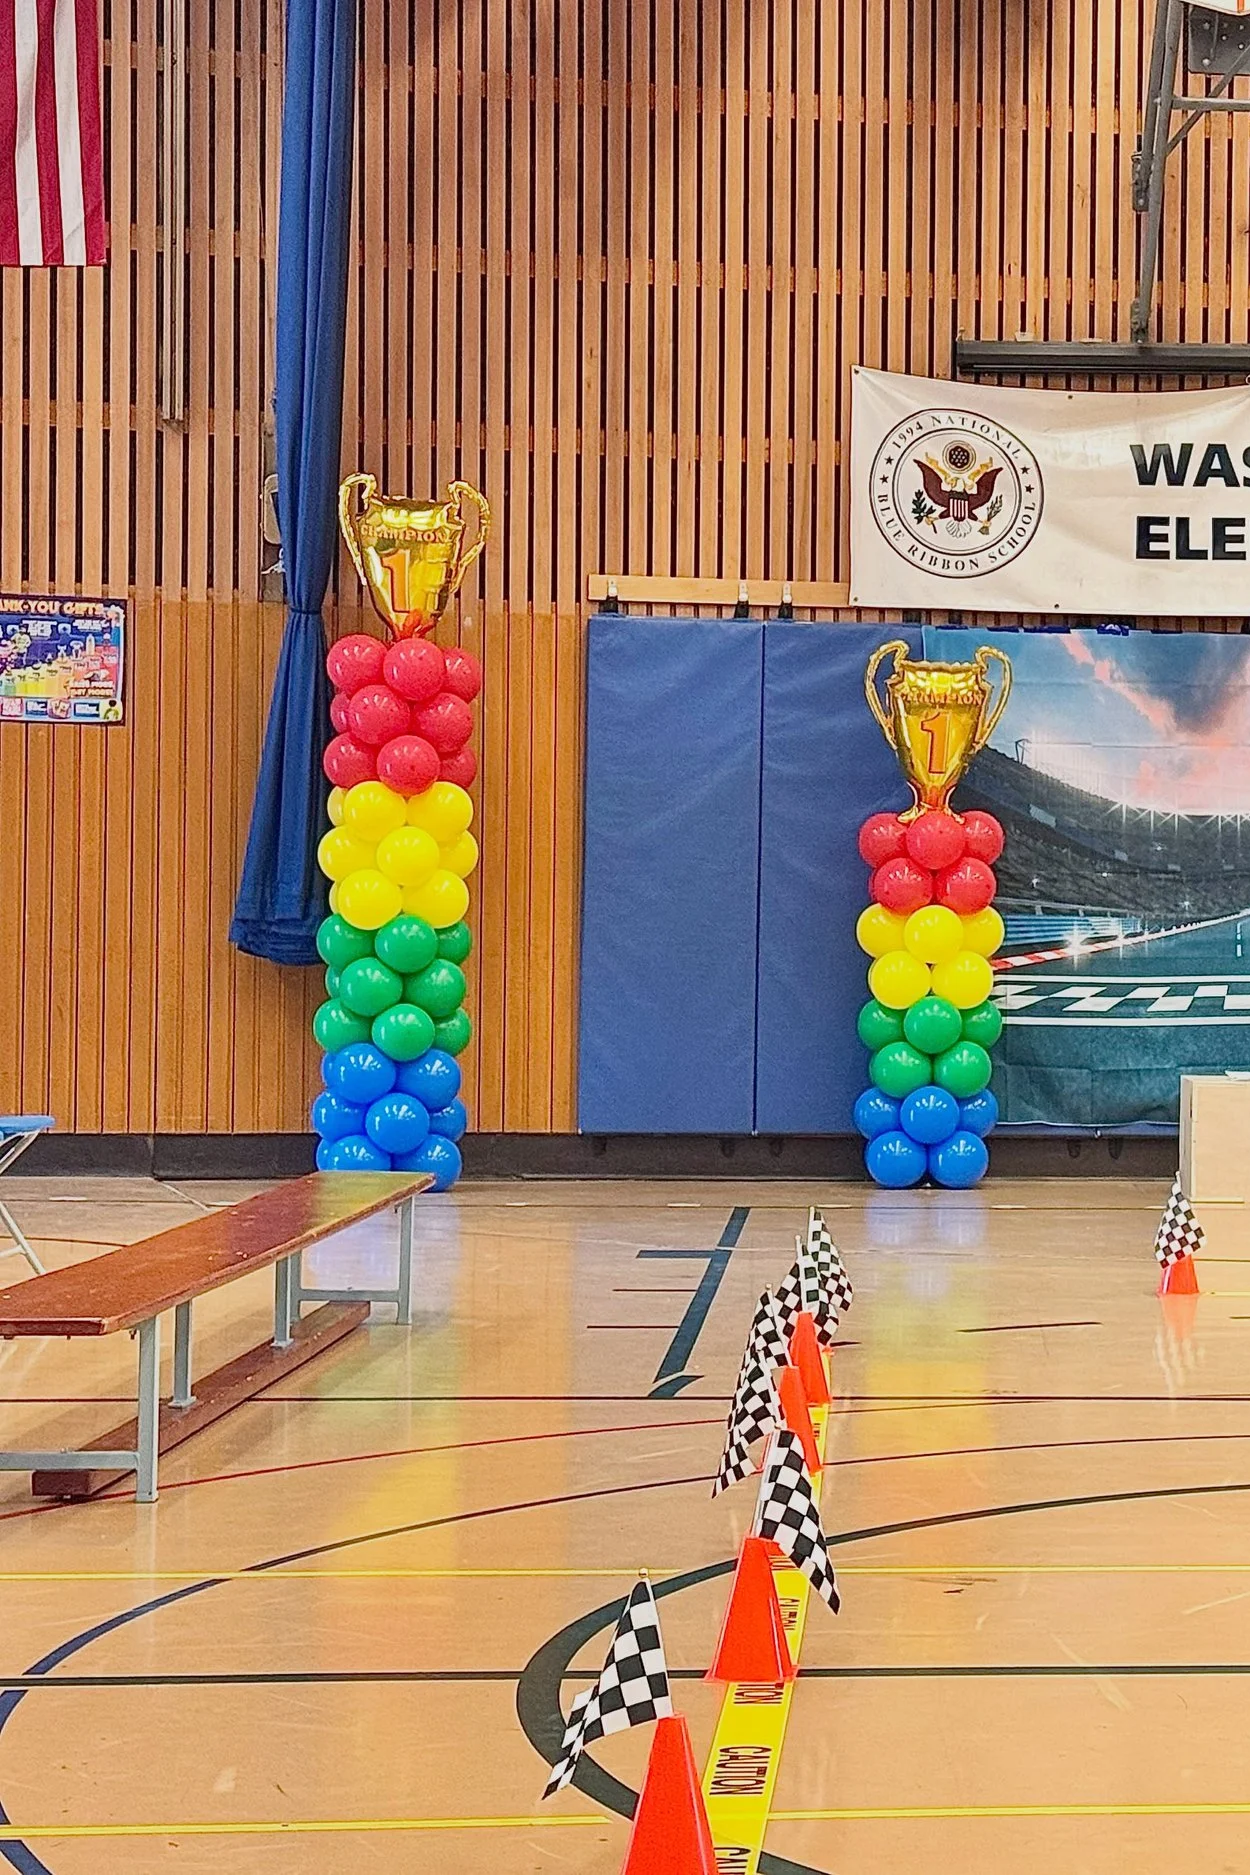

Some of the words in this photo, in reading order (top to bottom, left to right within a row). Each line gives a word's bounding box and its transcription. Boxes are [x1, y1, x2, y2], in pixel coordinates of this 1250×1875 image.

[892, 420, 924, 450] 1994
[930, 415, 1022, 460] NATIONAL
[877, 493, 905, 542] BLUE
[907, 543, 980, 571] RIBBON
[988, 501, 1037, 564] SCHOOL
[381, 549, 411, 614] 1
[920, 712, 950, 774] 1
[733, 1682, 785, 1704] TION
[709, 1746, 773, 1795] CAUTION
